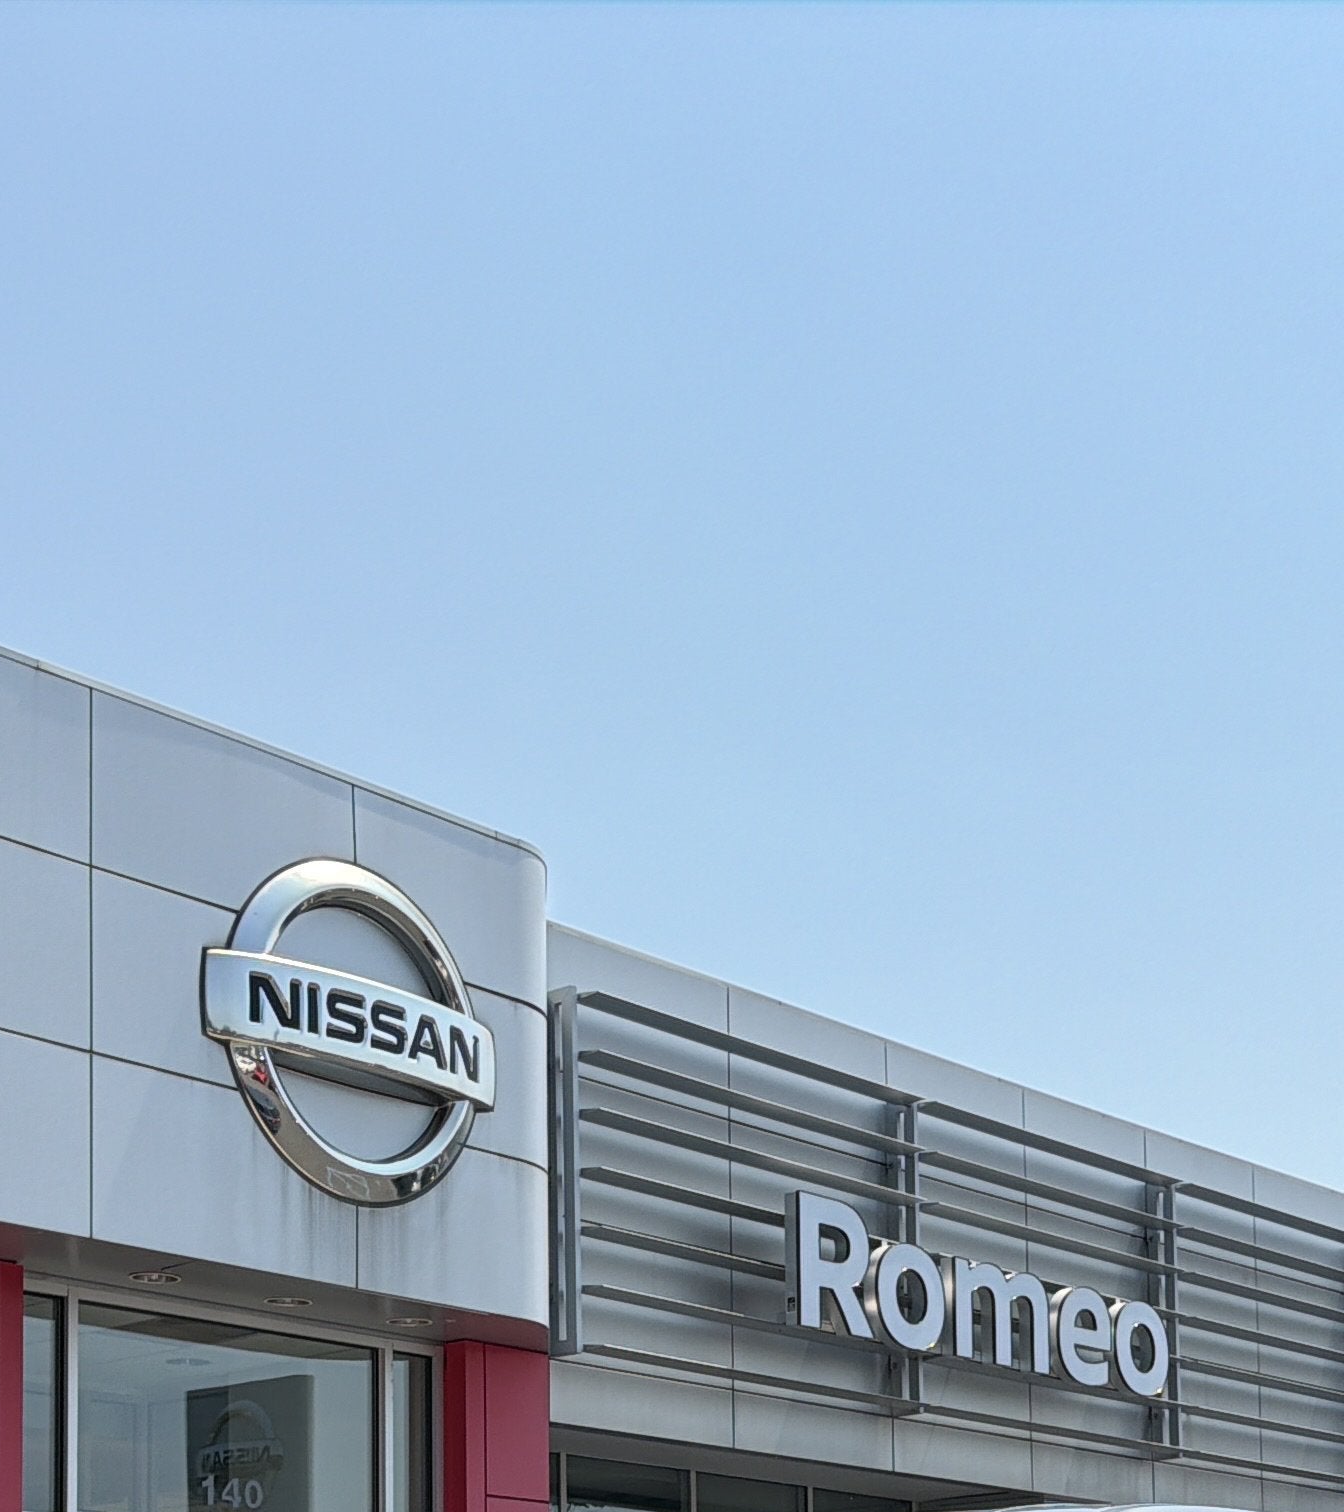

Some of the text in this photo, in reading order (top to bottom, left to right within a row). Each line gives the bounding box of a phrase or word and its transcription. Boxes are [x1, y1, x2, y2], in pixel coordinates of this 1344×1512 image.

[248, 970, 481, 1084] NISSAN
[787, 1190, 1169, 1397] Romeo
[201, 1474, 264, 1509] 140
